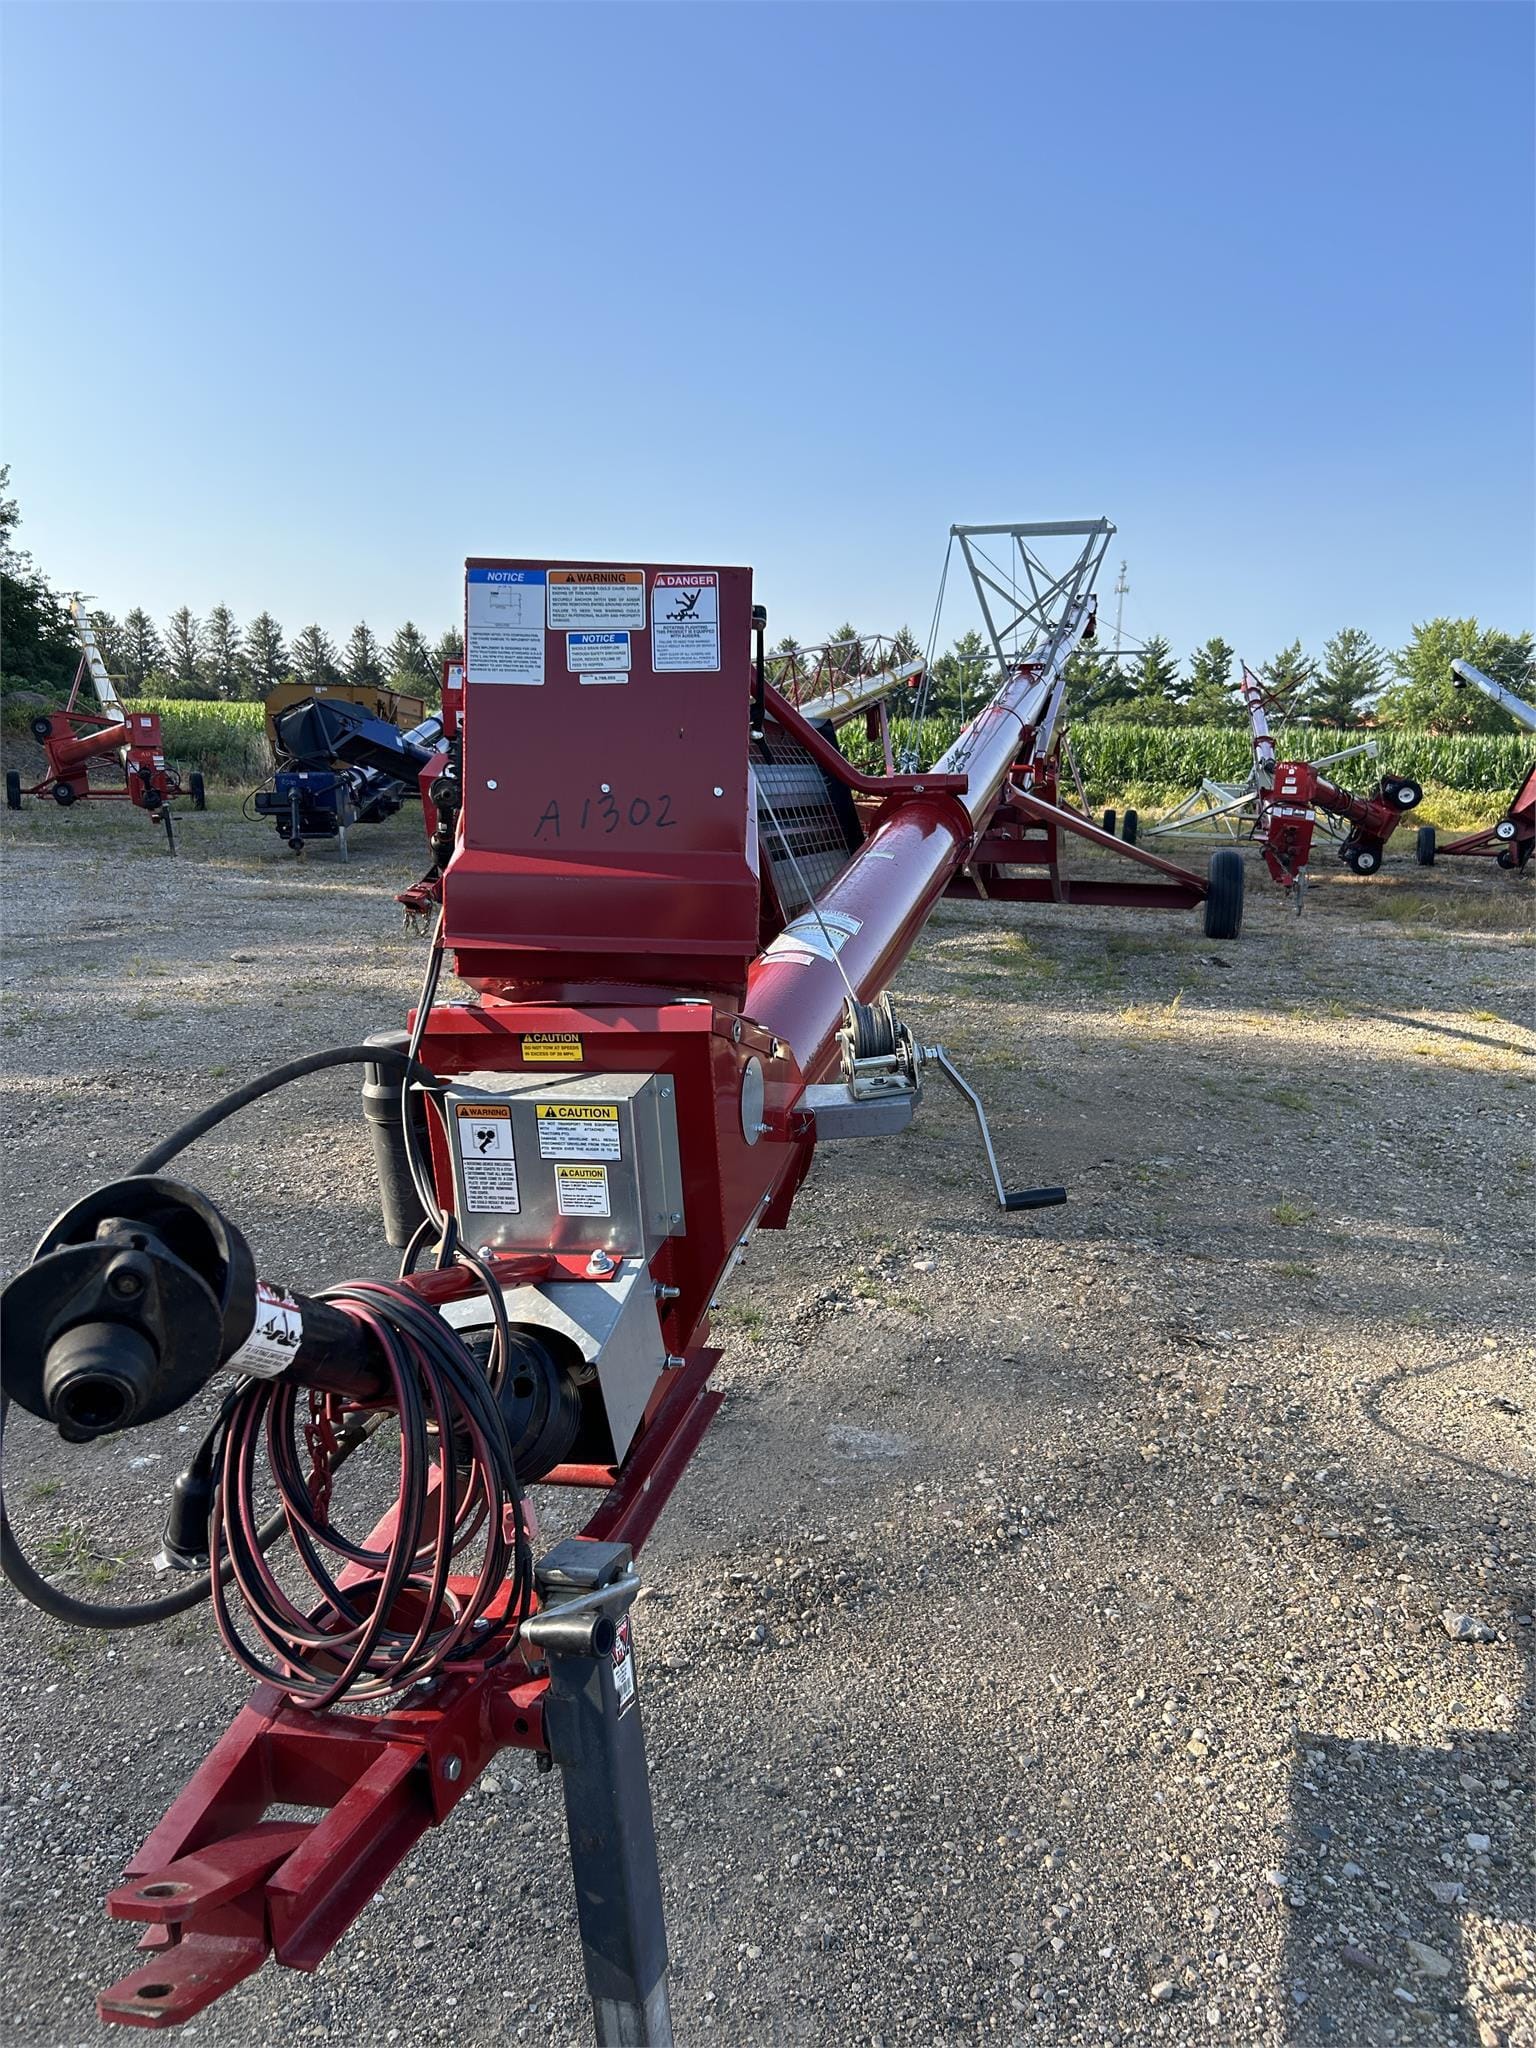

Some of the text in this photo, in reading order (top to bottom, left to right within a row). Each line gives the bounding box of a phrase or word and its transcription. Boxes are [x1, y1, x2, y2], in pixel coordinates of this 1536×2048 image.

[487, 572, 525, 582] NOTICE
[577, 574, 626, 583] WARNING
[667, 576, 713, 586] DANGER
[582, 634, 615, 643] NOTICE
[534, 1034, 579, 1042] CAUTION
[559, 1108, 610, 1118] CAUTION
